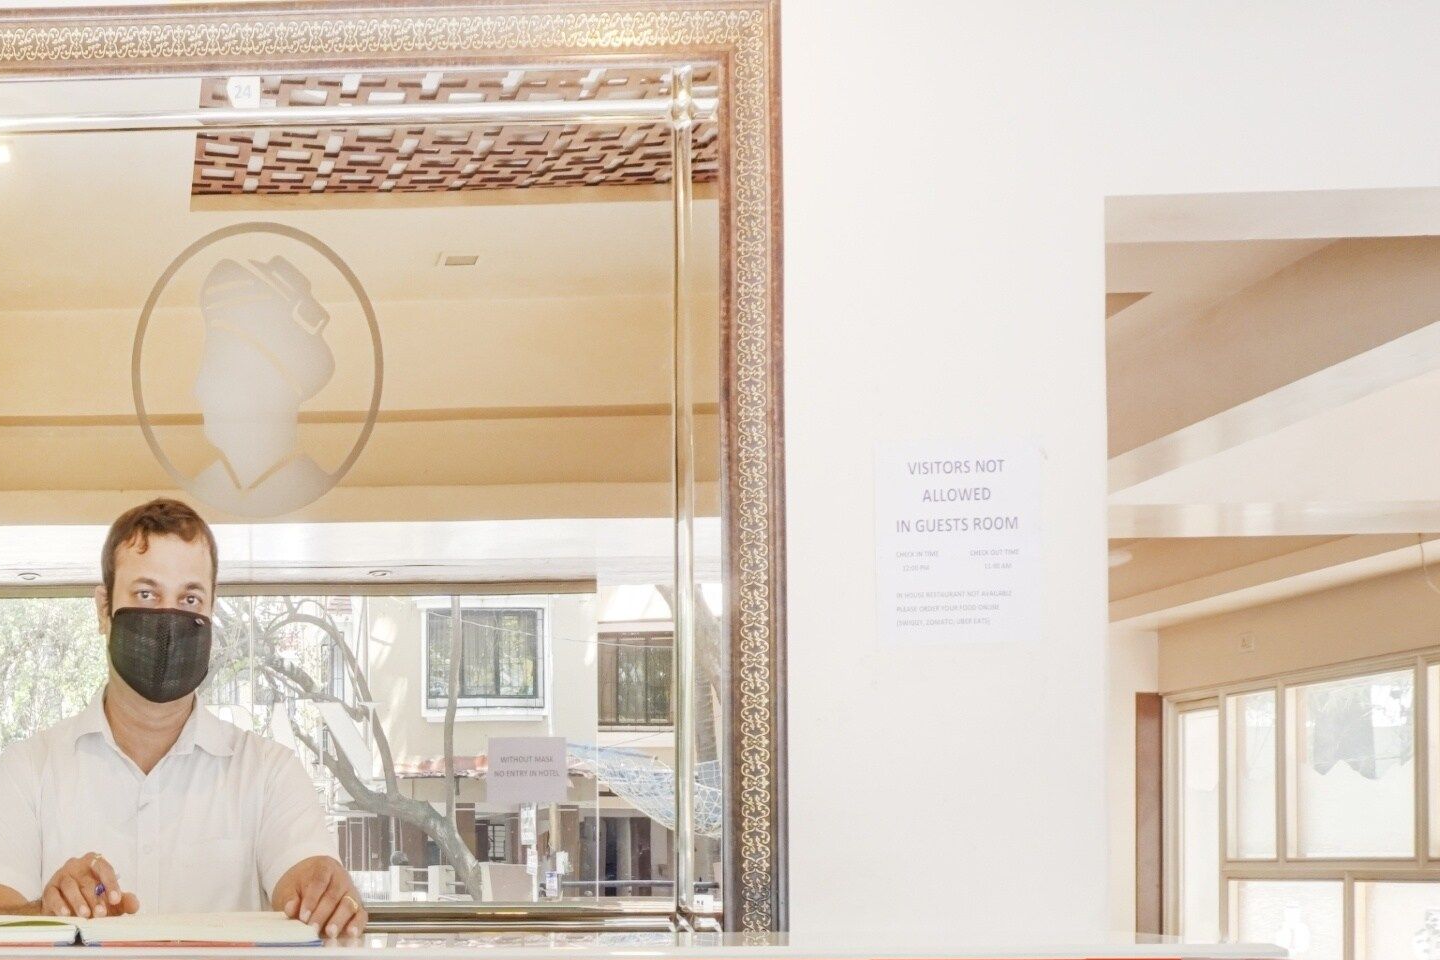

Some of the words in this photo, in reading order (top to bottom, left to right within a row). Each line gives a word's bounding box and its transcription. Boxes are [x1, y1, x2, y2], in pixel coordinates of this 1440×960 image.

[907, 461, 970, 475] VISITORS
[975, 459, 1005, 473] NOT
[922, 487, 991, 502] ALLOWED
[896, 519, 910, 533] IN
[915, 518, 968, 533] GUESTS
[973, 516, 1018, 530] ROOM
[539, 769, 560, 777] HOTEL
